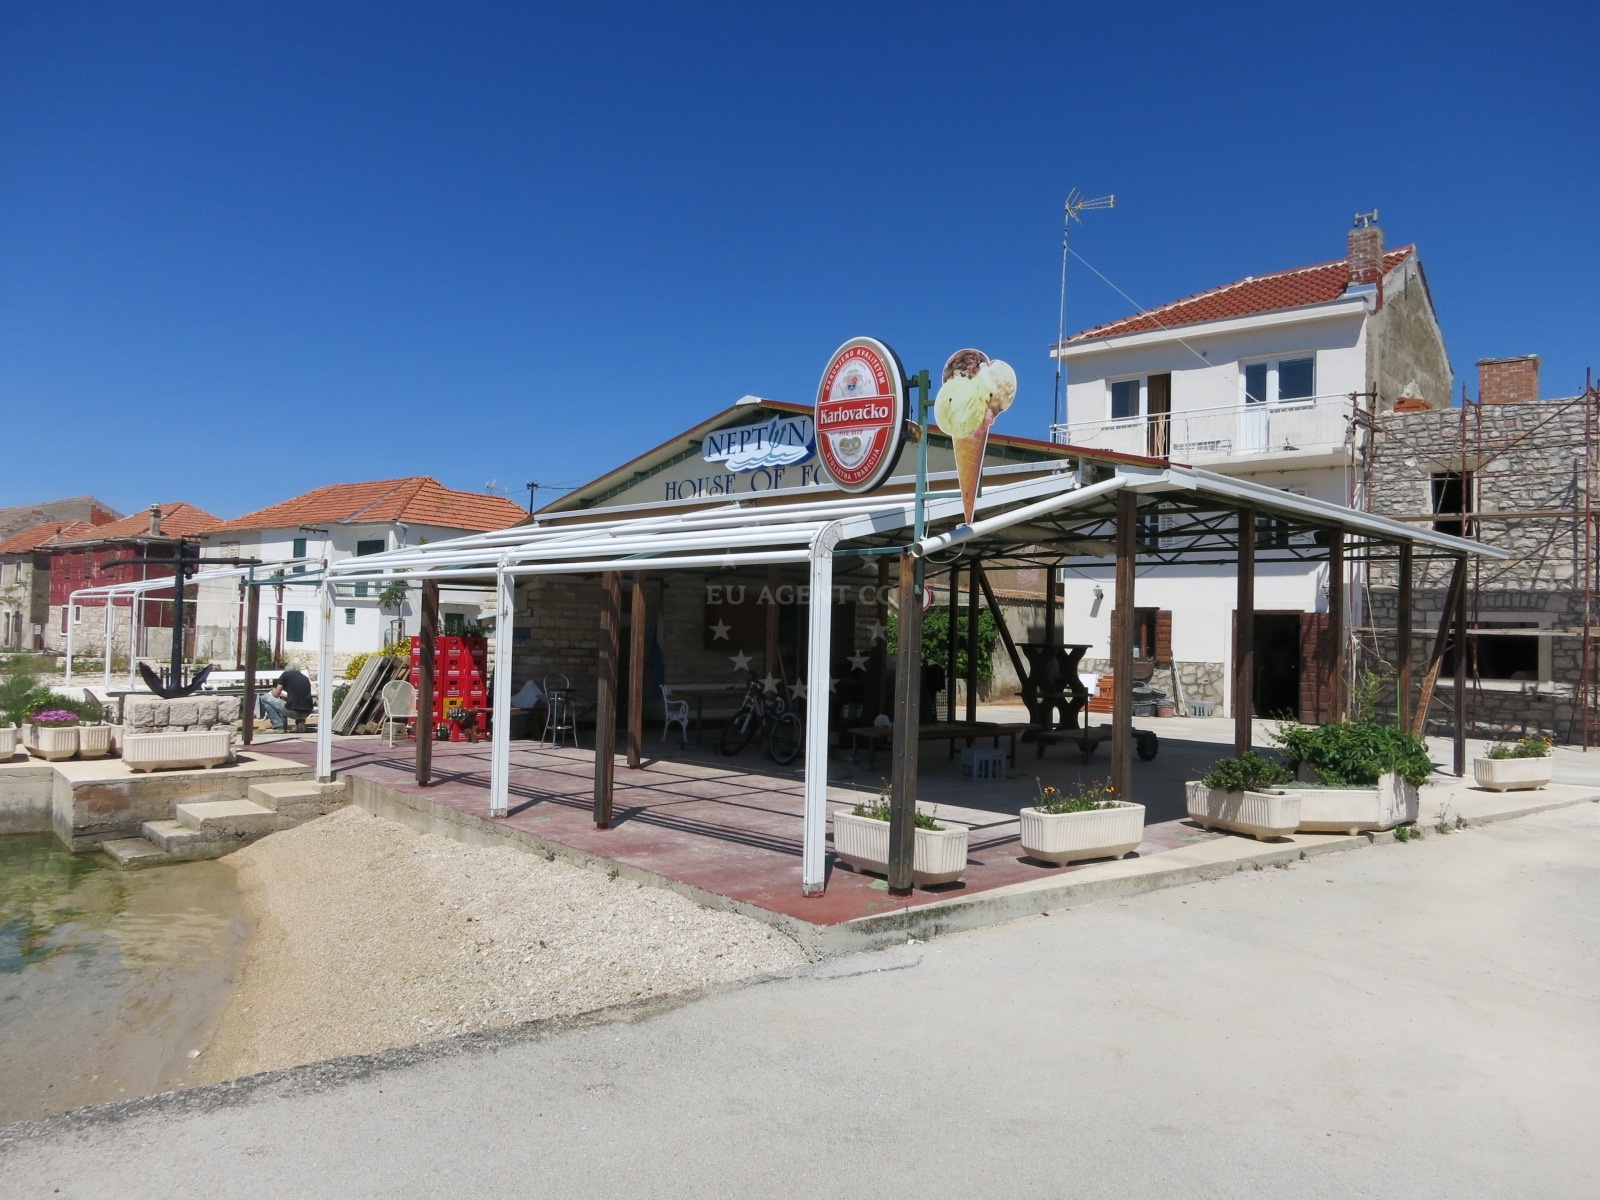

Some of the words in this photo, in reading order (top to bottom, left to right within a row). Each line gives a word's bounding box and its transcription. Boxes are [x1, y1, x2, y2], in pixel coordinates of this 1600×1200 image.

[825, 350, 854, 391] OKRUNJENO
[856, 348, 886, 385] KVALITETOM
[820, 403, 889, 425] Karlovačko
[708, 420, 807, 458] NEPTUN
[826, 452, 852, 480] STOLJETNA
[854, 448, 880, 480] TRADICIJA
[665, 473, 736, 501] HOUSE
[751, 467, 785, 491] OF
